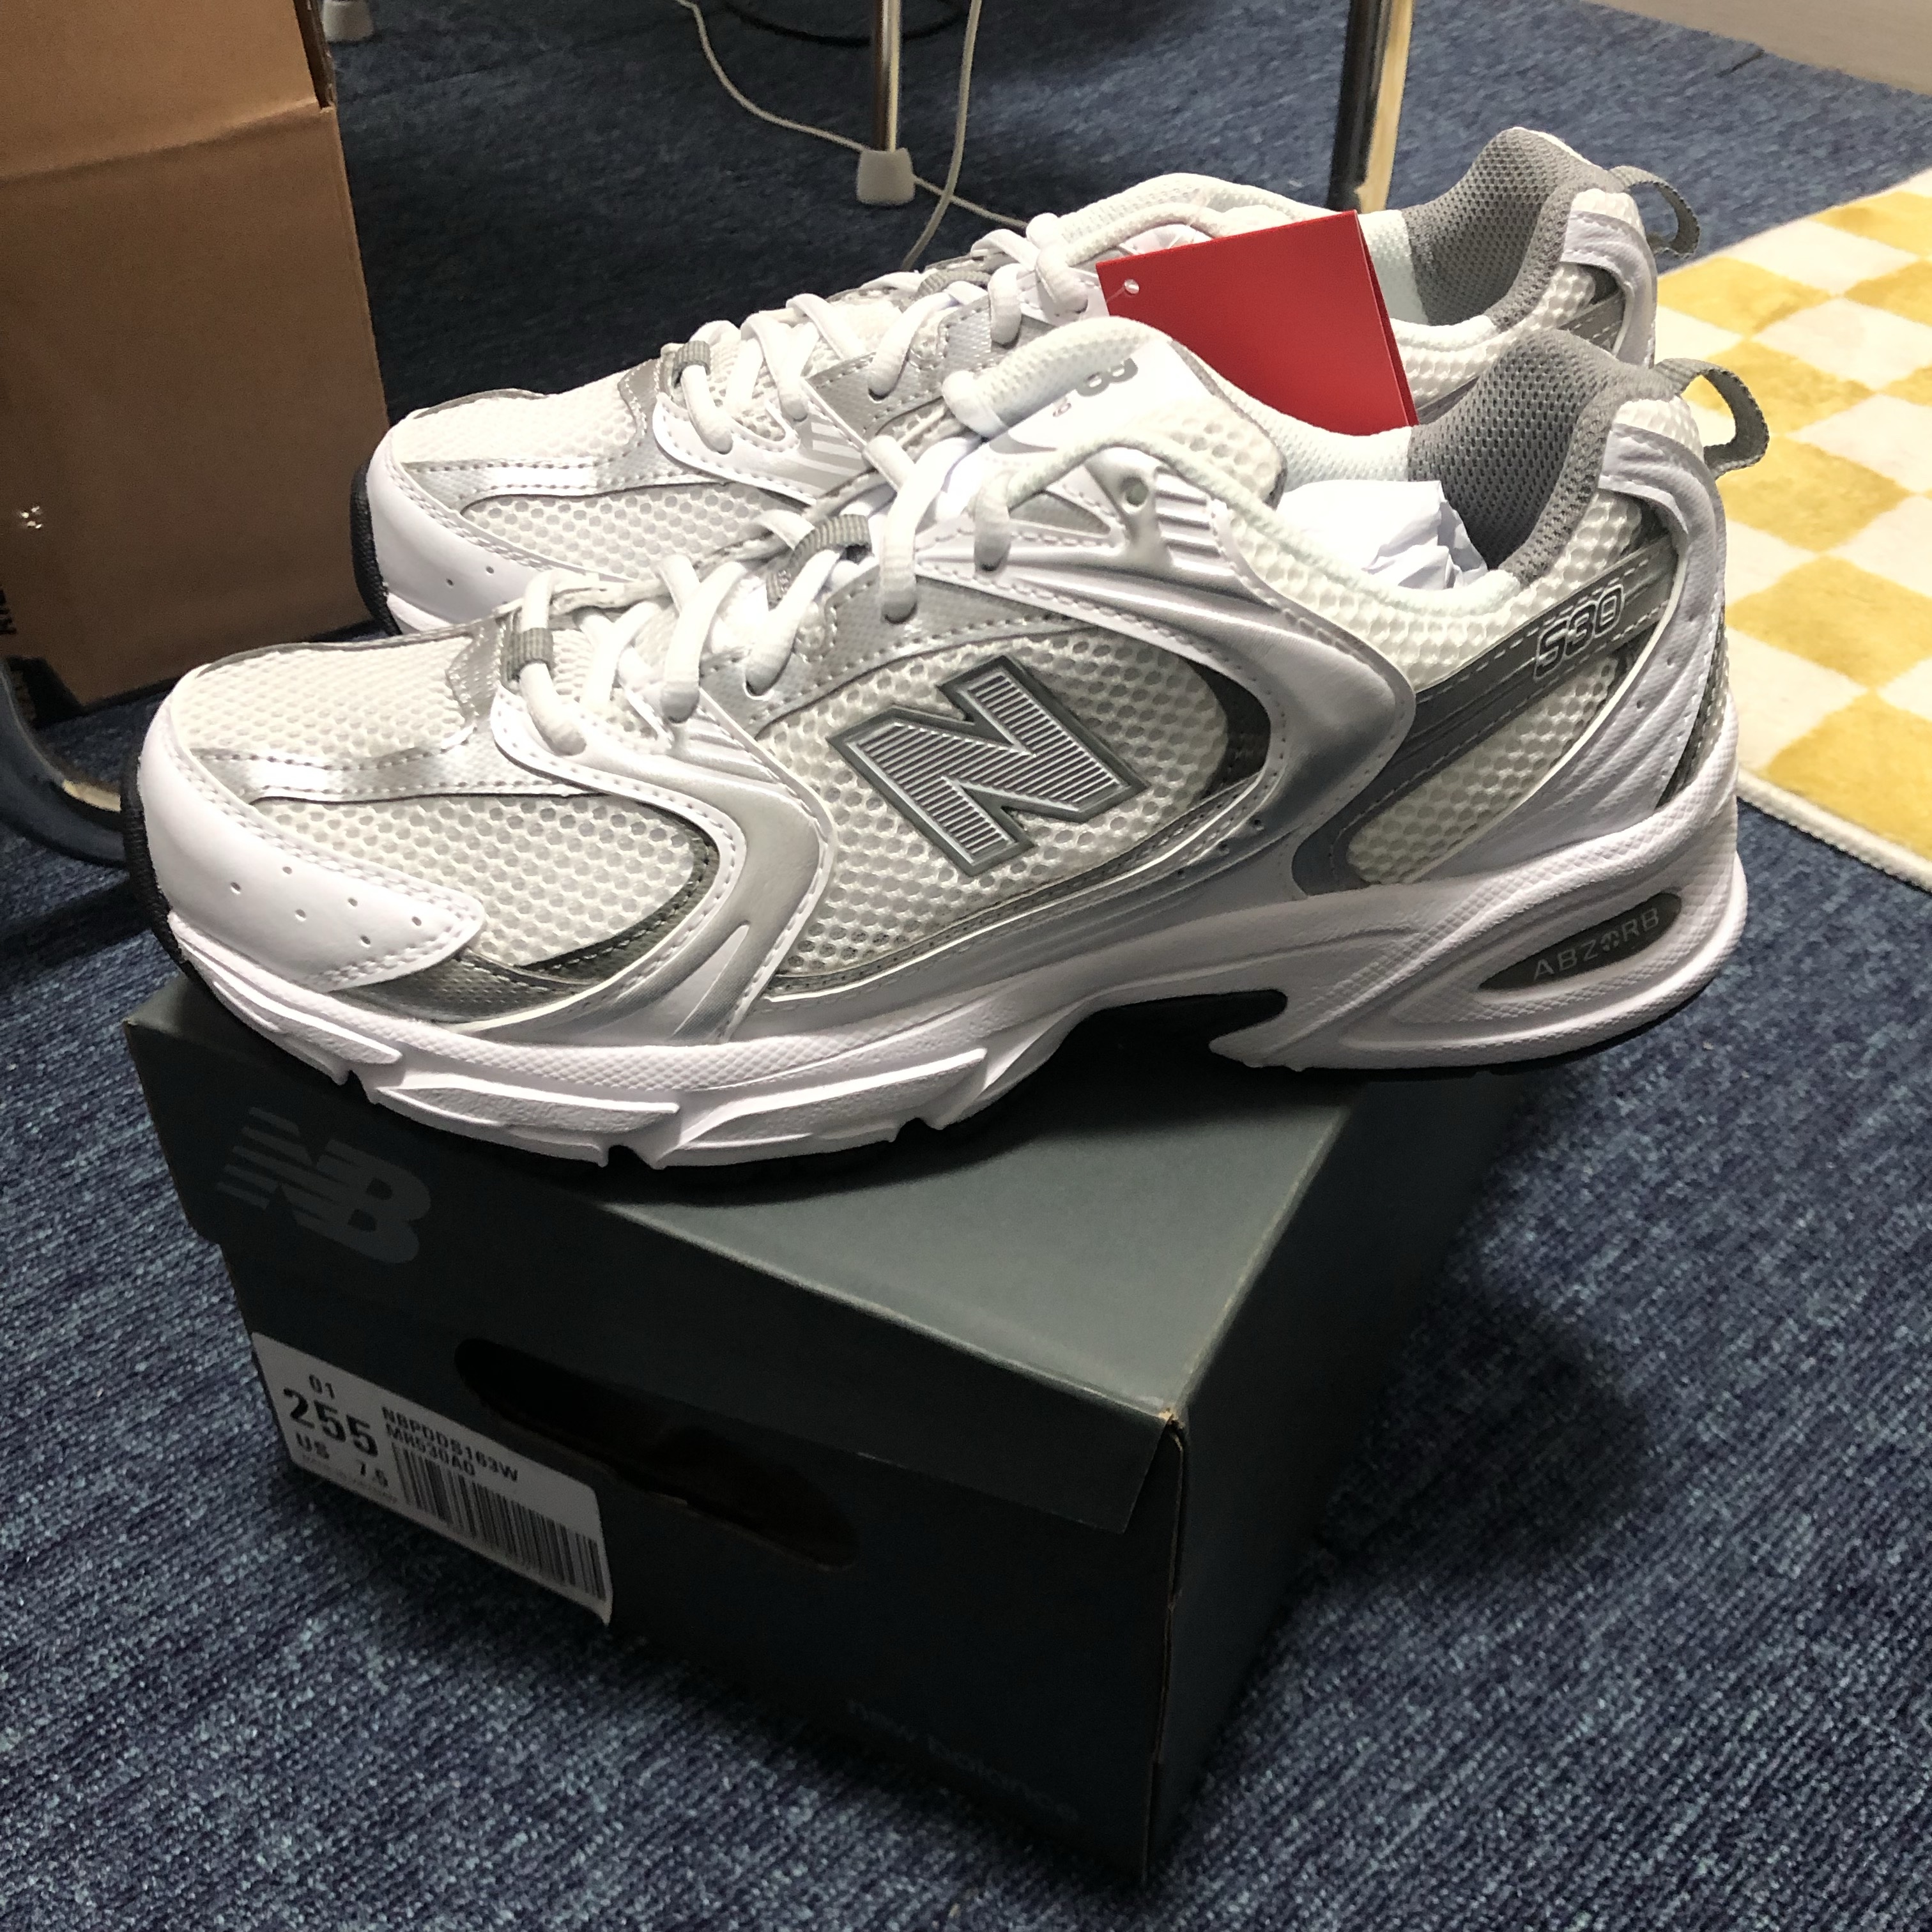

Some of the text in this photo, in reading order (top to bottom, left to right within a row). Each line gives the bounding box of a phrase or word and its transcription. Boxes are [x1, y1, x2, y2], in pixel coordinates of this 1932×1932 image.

[1534, 583, 1625, 680] 530
[826, 655, 1147, 877] N
[283, 1387, 379, 1457] 255
[309, 1374, 336, 1399] 01
